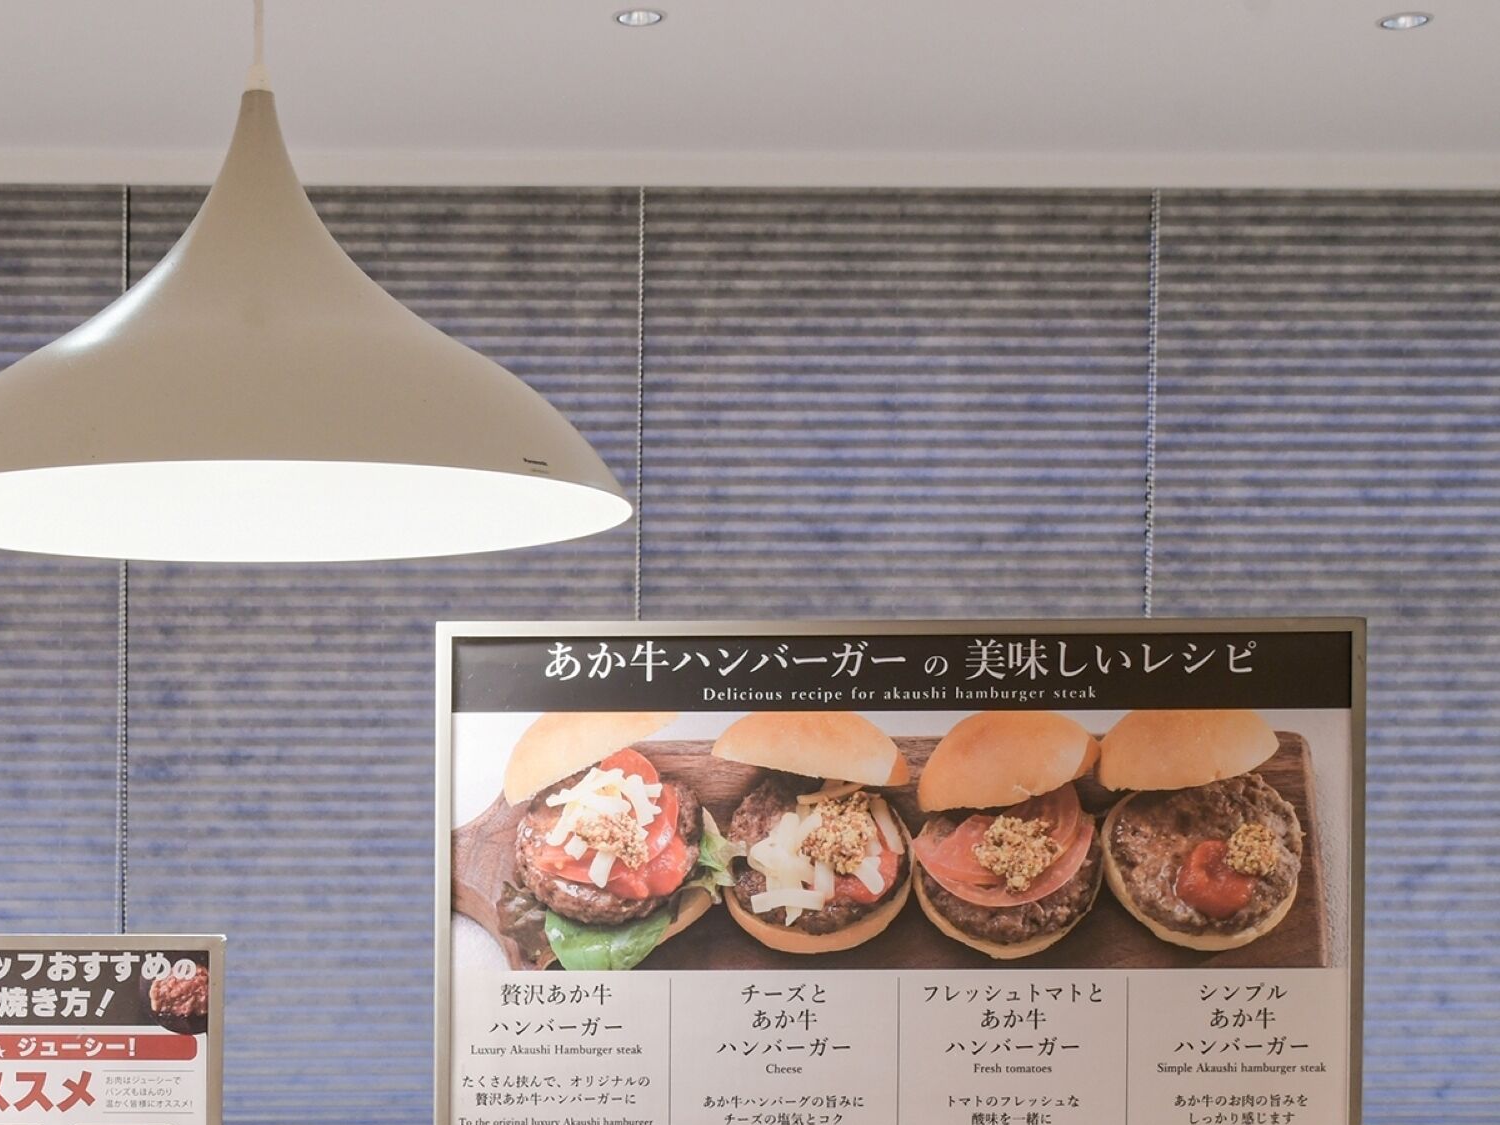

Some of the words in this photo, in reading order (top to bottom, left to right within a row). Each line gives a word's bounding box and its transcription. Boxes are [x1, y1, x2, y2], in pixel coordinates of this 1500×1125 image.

[544, 641, 905, 680] あか牛ハンバーガー
[925, 656, 948, 676] の
[966, 639, 1256, 680] 美味しいレシピ
[704, 688, 782, 700] Delicious
[792, 688, 842, 703] recipe
[852, 687, 875, 703] for
[884, 687, 945, 703] akaushi
[956, 687, 1044, 701] hamburger
[1054, 686, 1095, 703] steak
[502, 984, 612, 1006] 贅沢あか牛
[742, 984, 825, 1004] チーズと
[924, 983, 1102, 1002] フレッシュトマトと
[1201, 983, 1287, 1001] シンプル
[490, 1017, 622, 1036] ハンバーガー
[752, 1009, 817, 1030] あか牛
[981, 1008, 1046, 1030] あか牛
[1210, 1008, 1275, 1029] あか牛
[18, 1038, 136, 1056] ジューシー!
[471, 1045, 506, 1057] Luxury
[510, 1045, 550, 1054] Akaushi
[555, 1045, 612, 1057] Hamburger
[617, 1044, 642, 1054] steak
[717, 1037, 850, 1056] ハンバーガー
[946, 1037, 1079, 1056] ハンバーガー
[1175, 1036, 1308, 1055] ハンバーガー
[766, 1064, 802, 1073] Cheese
[974, 1063, 1001, 1073] Fresh
[1157, 1063, 1192, 1075] Simple
[1196, 1062, 1237, 1072] Akaushi
[1241, 1062, 1296, 1075] hamburger
[1301, 1062, 1326, 1072] steak
[463, 1076, 650, 1088] たくさん挟んで、オリジナルの
[704, 1095, 864, 1108] あか牛ハンバーグの旨みに
[949, 1095, 1079, 1107] トマトのフレッシュな
[1175, 1094, 1307, 1107] あか牛のお肉の旨みを
[459, 1118, 472, 1125] To
[476, 1118, 490, 1125] the
[563, 1118, 600, 1125] Akaushi
[725, 1113, 842, 1125] チーズの塩気とコク
[972, 1112, 1051, 1125] 酸味を一緒に
[1190, 1112, 1295, 1125] しっかり感じます
